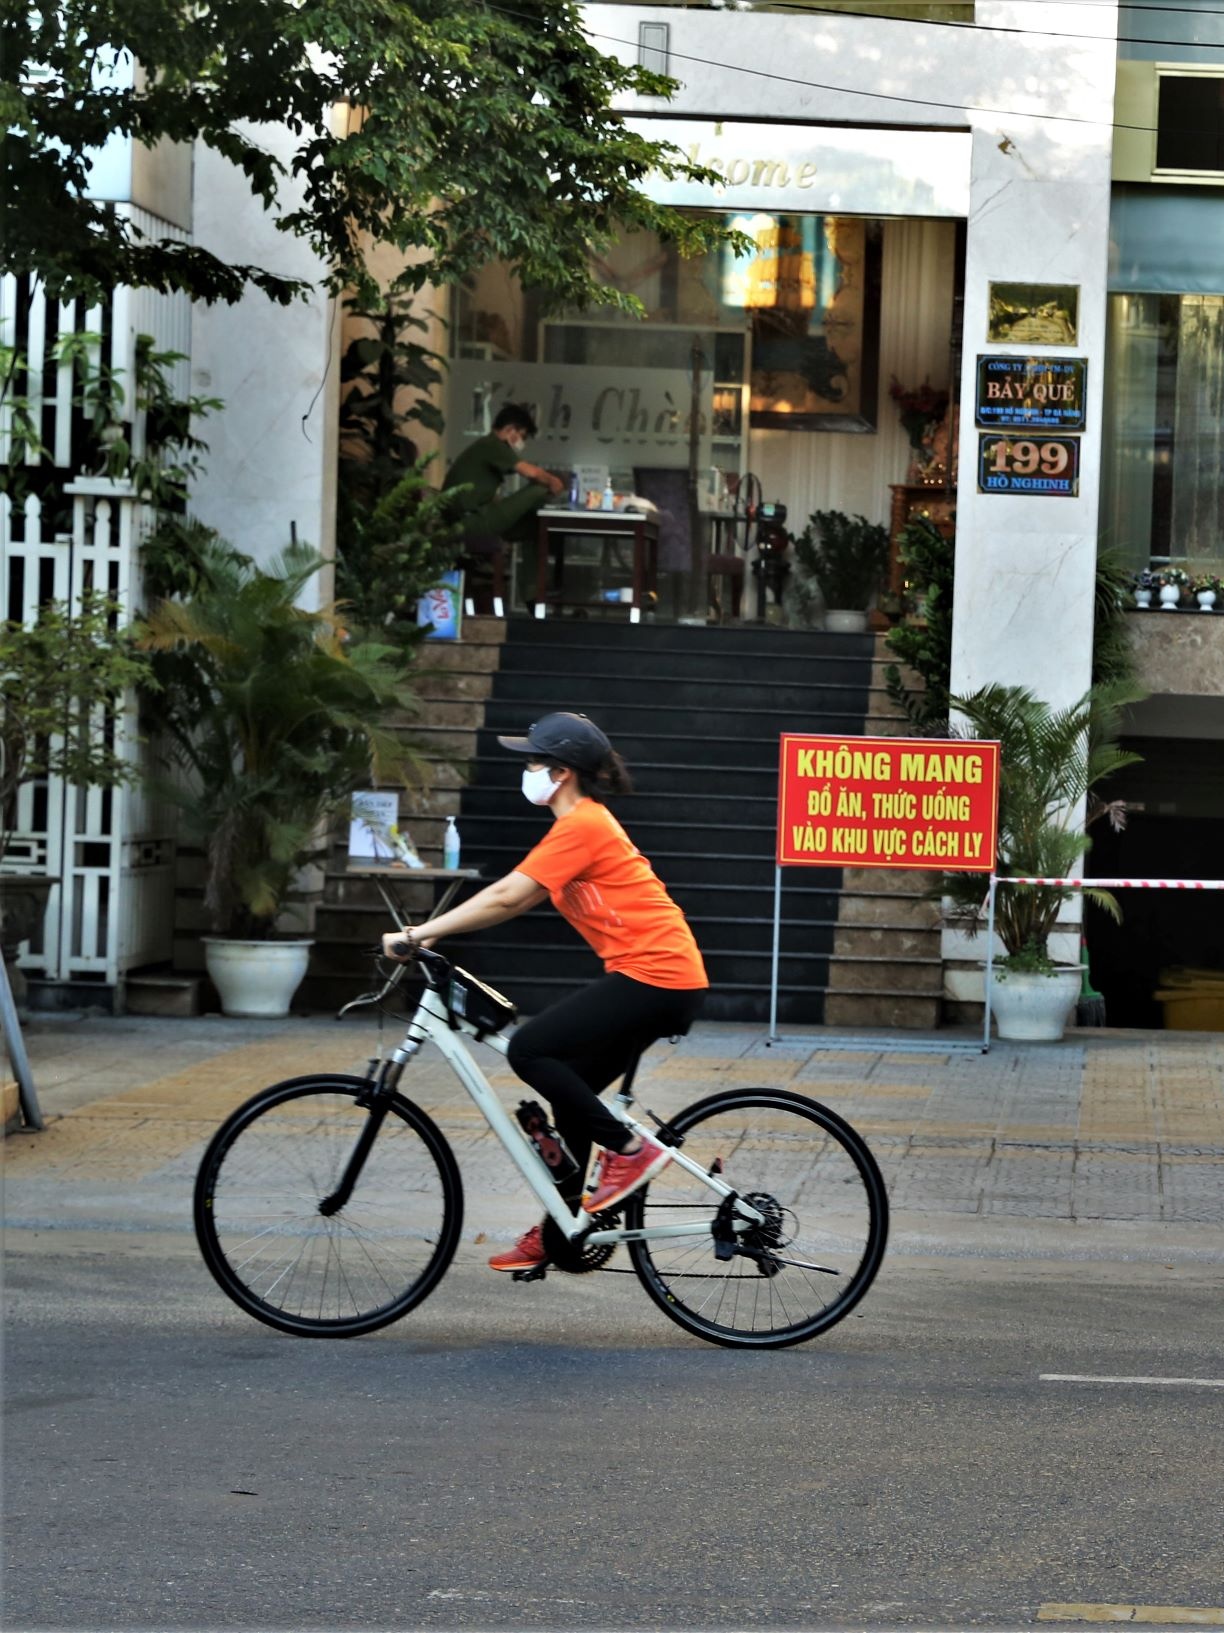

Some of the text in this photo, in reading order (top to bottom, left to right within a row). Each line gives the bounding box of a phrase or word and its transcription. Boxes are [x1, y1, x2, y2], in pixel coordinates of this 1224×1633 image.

[645, 142, 818, 189] lcome
[986, 376, 1076, 404] BẢY QUẾ
[989, 441, 1069, 475] 199
[987, 473, 1070, 491] HỒ NGHINH
[797, 745, 982, 784] KHÔNG MANG
[836, 786, 866, 821] ĂN,
[872, 788, 917, 820] THỨC
[922, 786, 970, 821] UỐNG
[793, 820, 983, 861] VÀO KHU VỰC CÁCH LY
